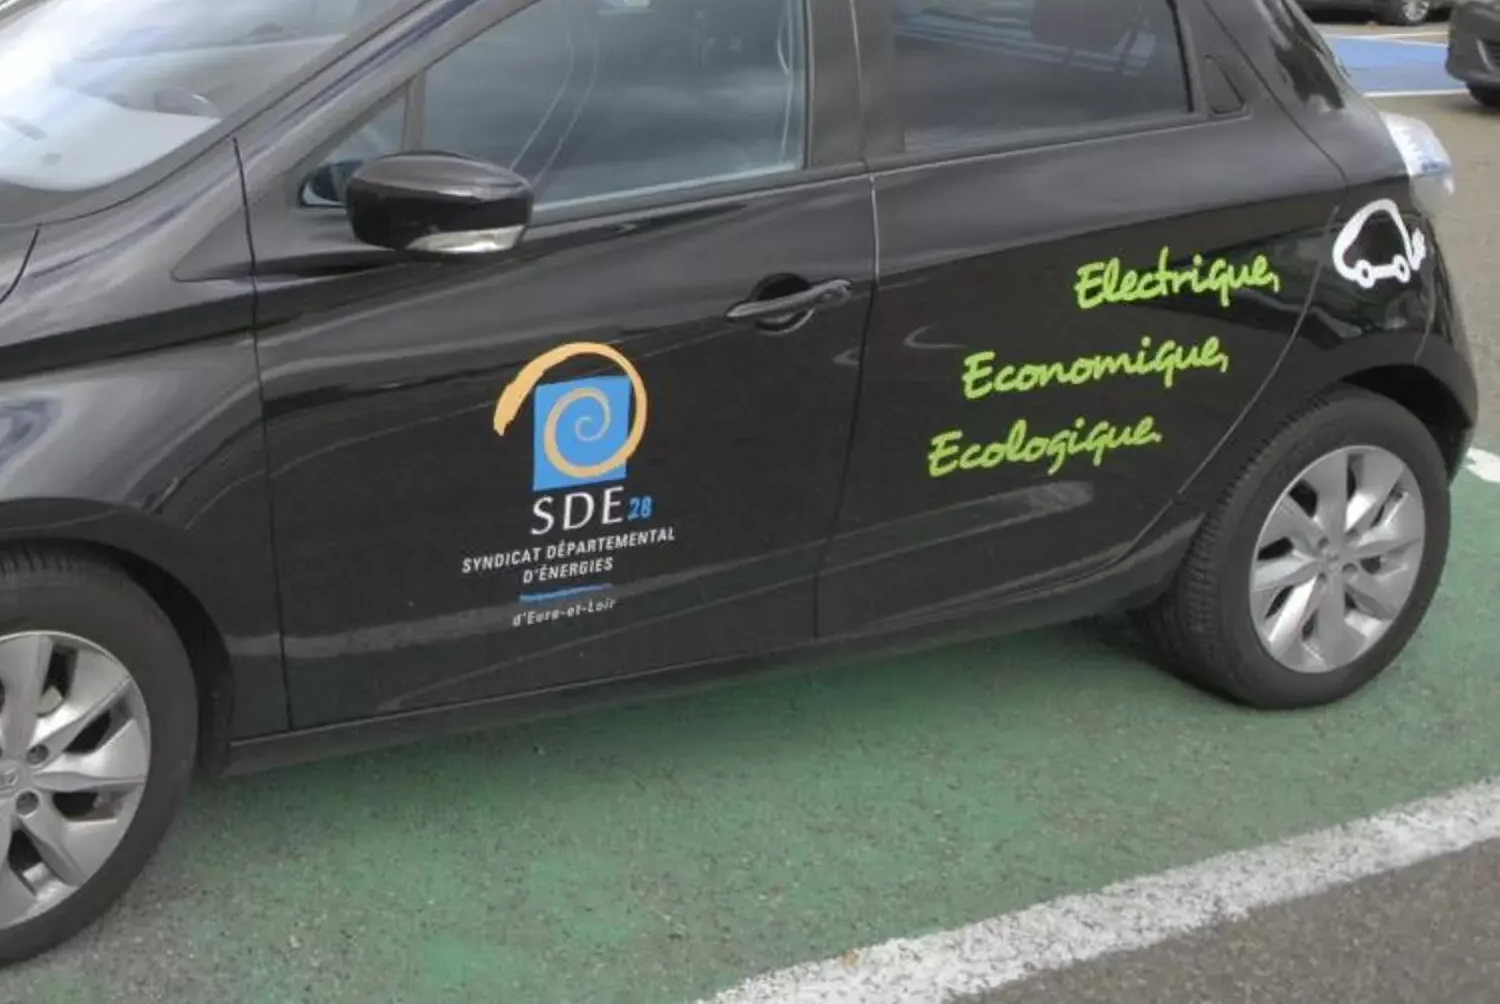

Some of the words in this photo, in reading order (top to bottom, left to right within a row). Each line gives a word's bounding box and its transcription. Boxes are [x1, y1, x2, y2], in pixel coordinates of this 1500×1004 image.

[1074, 245, 1280, 309] Electrique,
[961, 336, 1228, 400] Economique,
[461, 546, 542, 574] SYNDICAT
[546, 526, 675, 560] DÉPARTEMENTAL
[523, 556, 614, 584] D'ÉNERGIES
